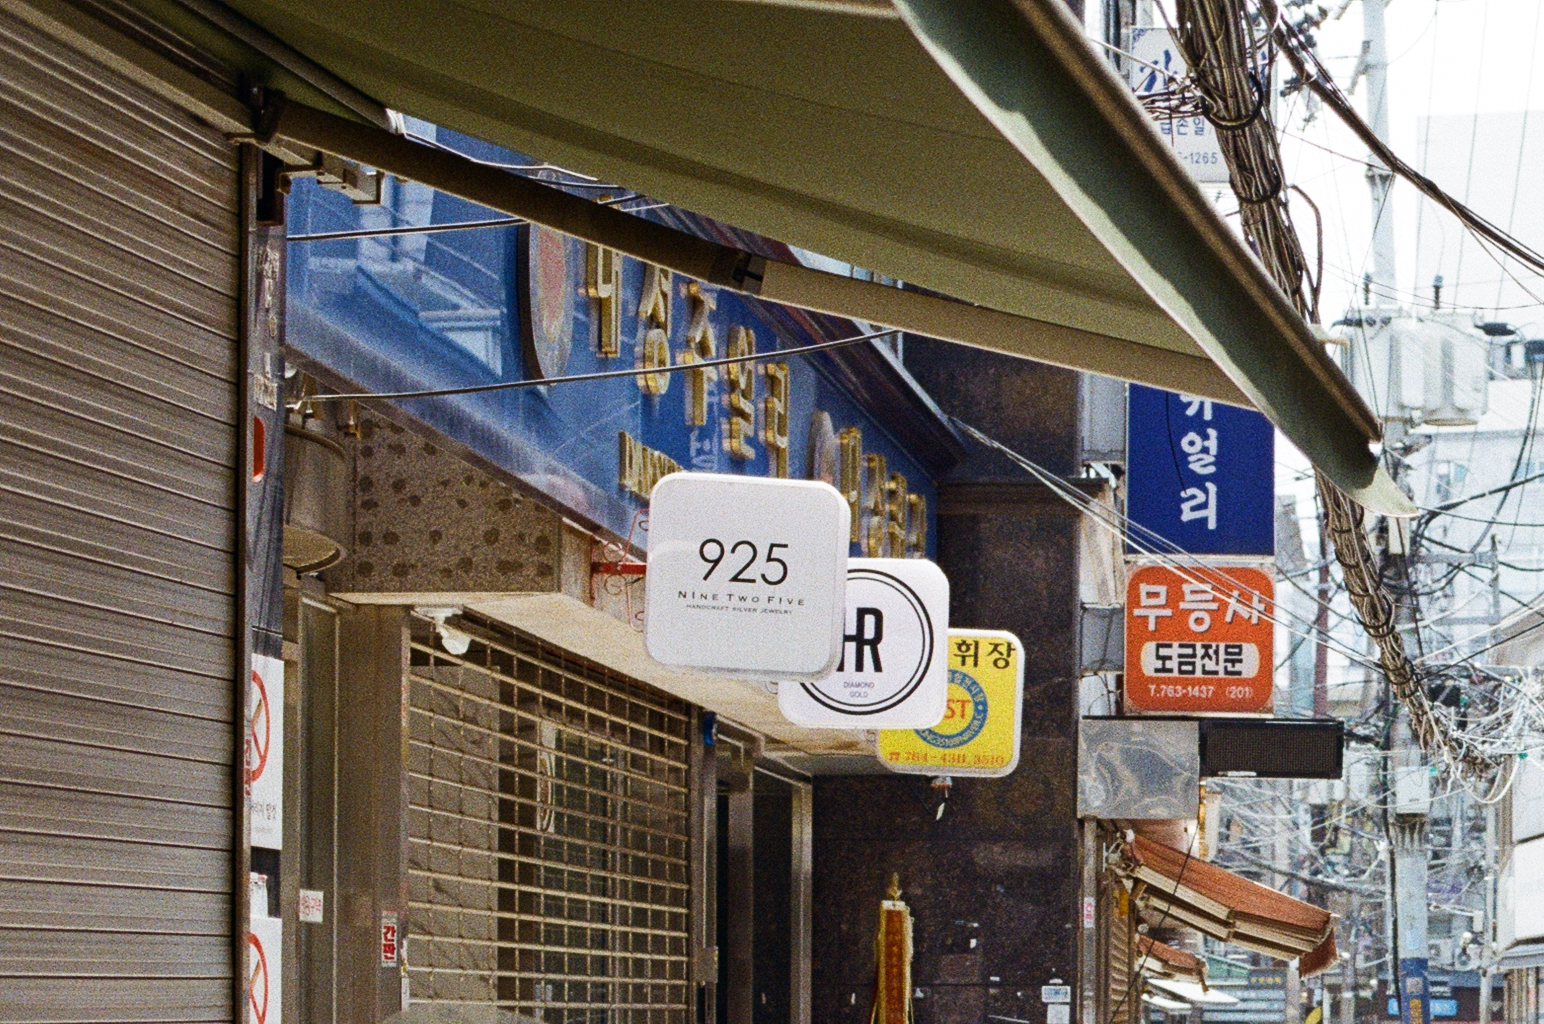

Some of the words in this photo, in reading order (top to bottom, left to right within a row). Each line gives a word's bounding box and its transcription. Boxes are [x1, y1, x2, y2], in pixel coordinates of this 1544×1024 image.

[698, 537, 789, 586] 925
[1132, 582, 1266, 633] 무등사
[1153, 642, 1244, 677] 도금전문
[843, 681, 875, 689] DIAMOND
